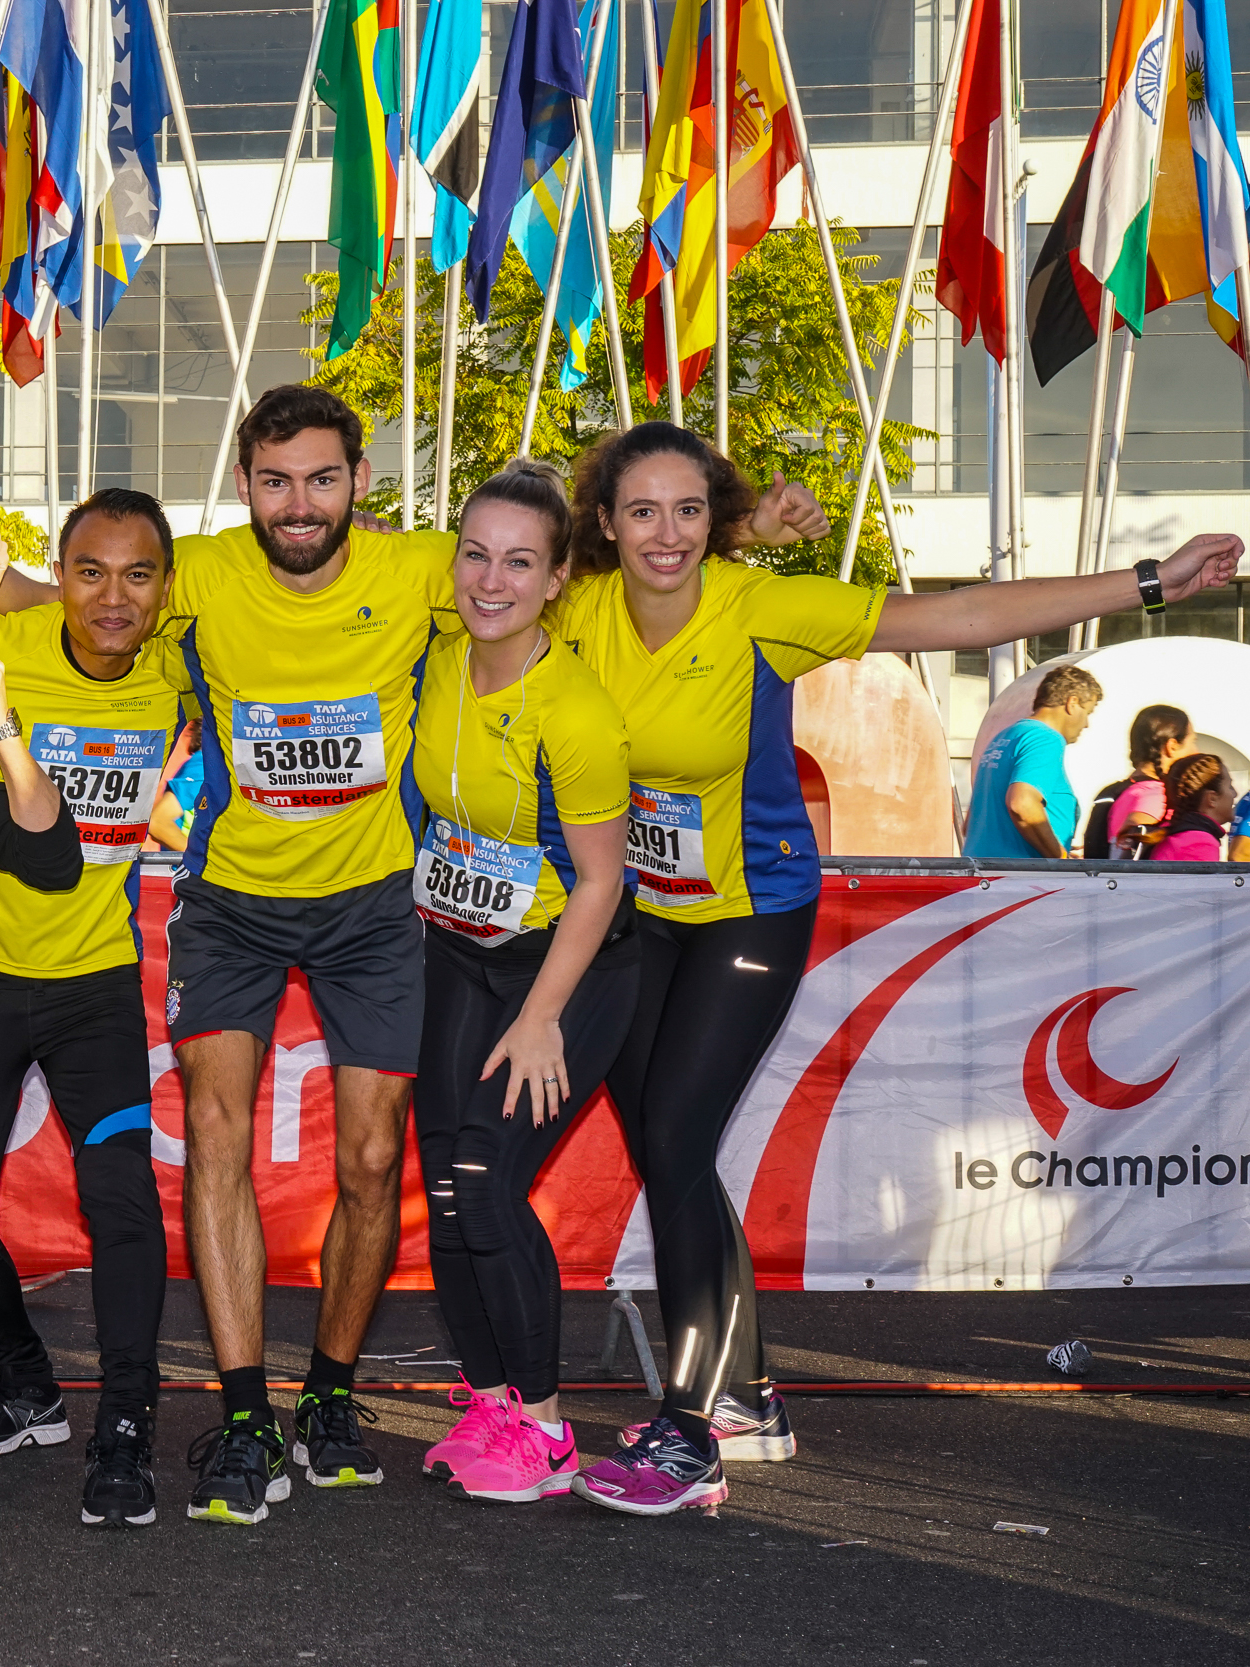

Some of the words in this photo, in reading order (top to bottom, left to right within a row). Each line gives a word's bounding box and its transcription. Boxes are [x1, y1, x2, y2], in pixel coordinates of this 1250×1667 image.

[341, 619, 388, 632] SUNSHOWER
[110, 700, 151, 708] SUNSHOWER
[314, 704, 346, 714] TATA
[310, 711, 368, 725] NSULTANCY
[244, 726, 283, 738] TATA
[308, 723, 356, 735] SERVICES
[113, 734, 140, 744] TATA
[40, 749, 77, 762] TATA
[88, 745, 102, 754] BUS
[115, 745, 155, 755] SULTANCY
[253, 736, 363, 772] 53802
[102, 756, 143, 766] SERVICES
[49, 765, 141, 803] 53794
[268, 771, 354, 786] Sunshower
[249, 789, 259, 801] I
[263, 789, 374, 806] amsterdam
[634, 796, 645, 806] BUS
[645, 801, 652, 809] 17
[642, 790, 671, 801] TATA
[68, 802, 129, 819] nshower
[639, 810, 680, 824] SERVICES
[628, 815, 680, 861] 3791
[432, 838, 449, 858] TATA
[481, 837, 510, 854] TATA
[472, 847, 530, 869] NSULTANCY
[626, 848, 677, 874] nshower
[470, 858, 514, 877] SERVICES
[425, 856, 514, 911] 53808
[431, 893, 493, 924] Sunshower
[433, 915, 504, 938] amsterda
[954, 1151, 998, 1190] le
[332, 1387, 350, 1396] NIKE
[232, 1411, 251, 1421] NIKE
